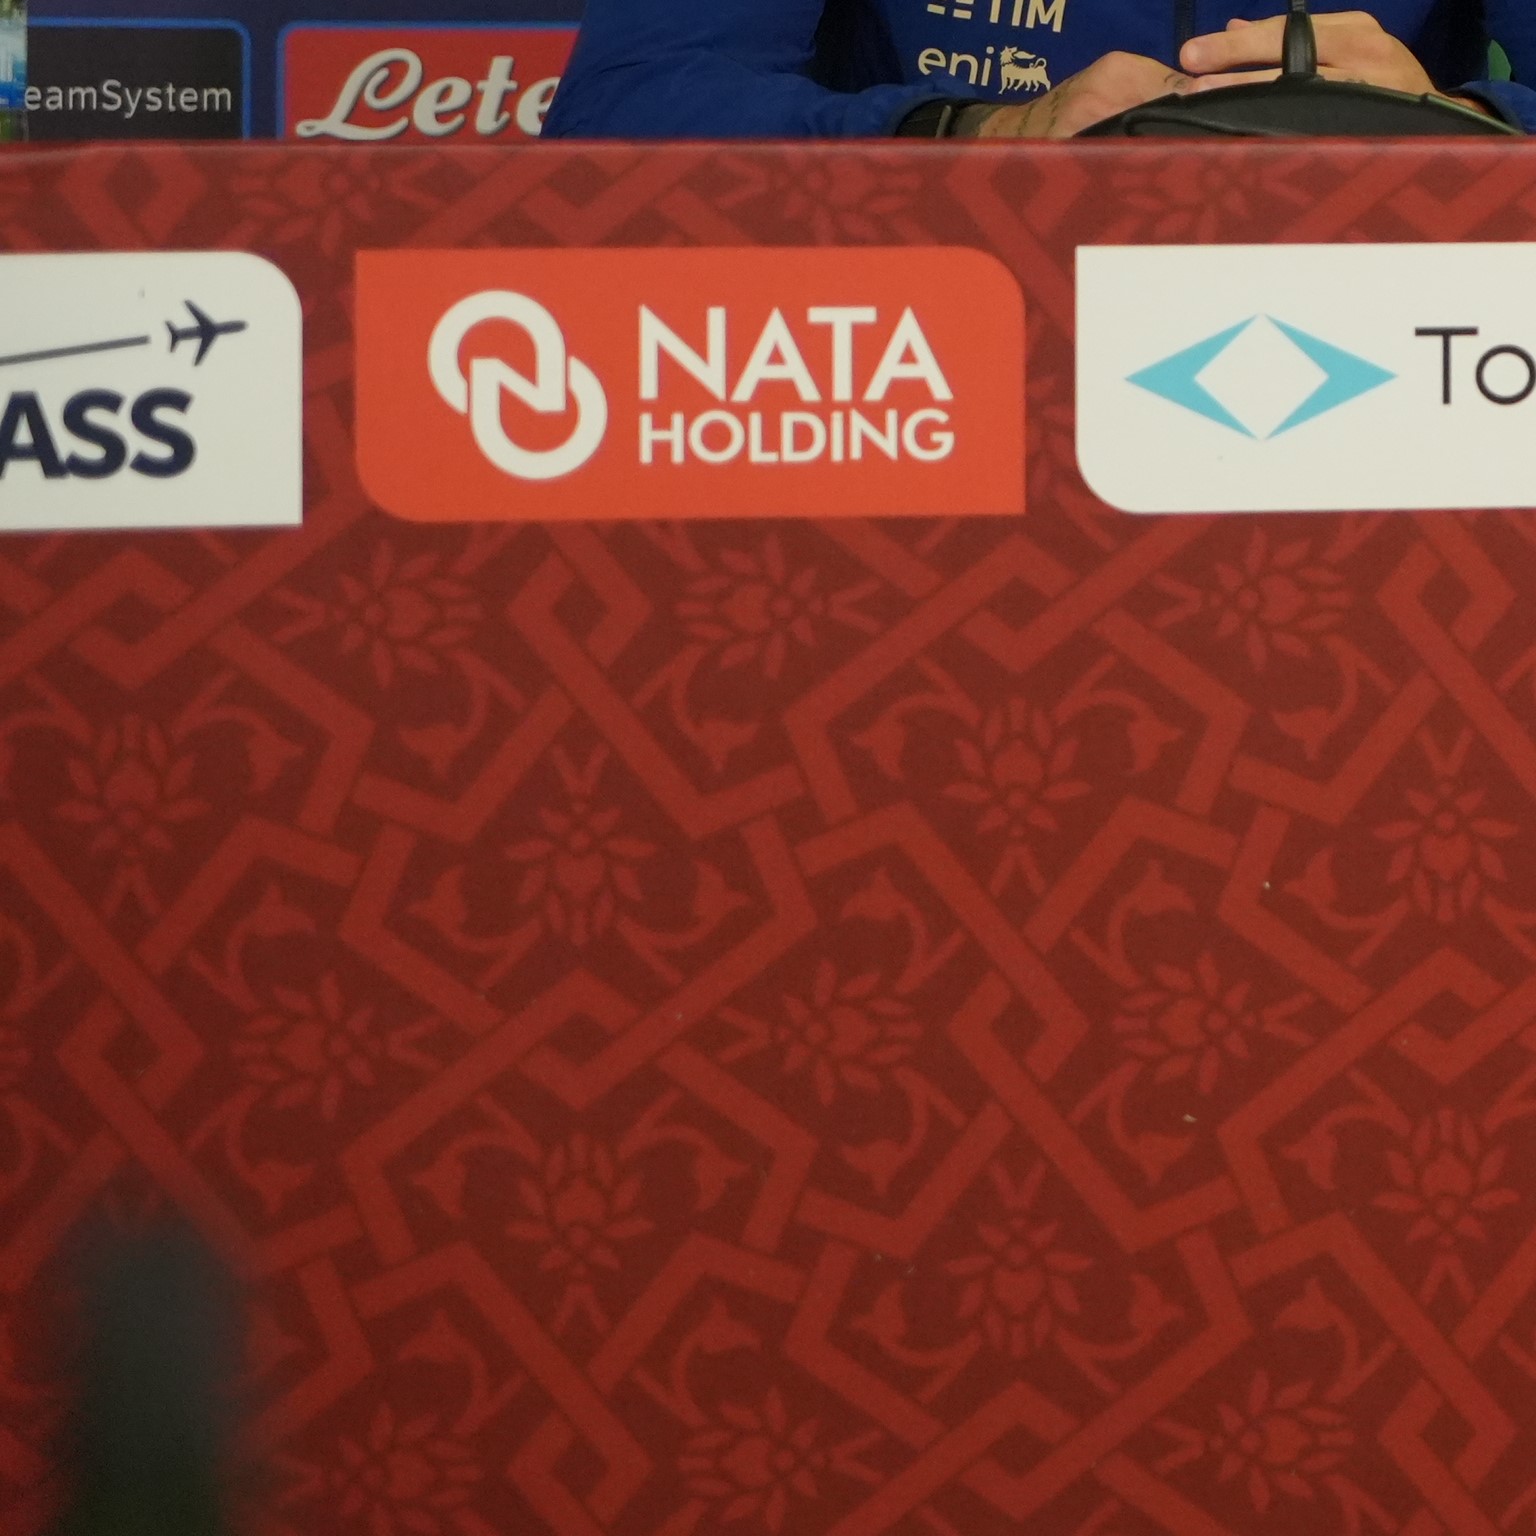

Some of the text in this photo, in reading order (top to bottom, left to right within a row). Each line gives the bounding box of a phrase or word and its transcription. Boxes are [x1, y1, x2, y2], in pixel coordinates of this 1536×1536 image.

[296, 48, 560, 140] Lete
[918, 46, 994, 87] eni
[639, 304, 954, 403] NATA
[639, 407, 955, 465] HOLDING
